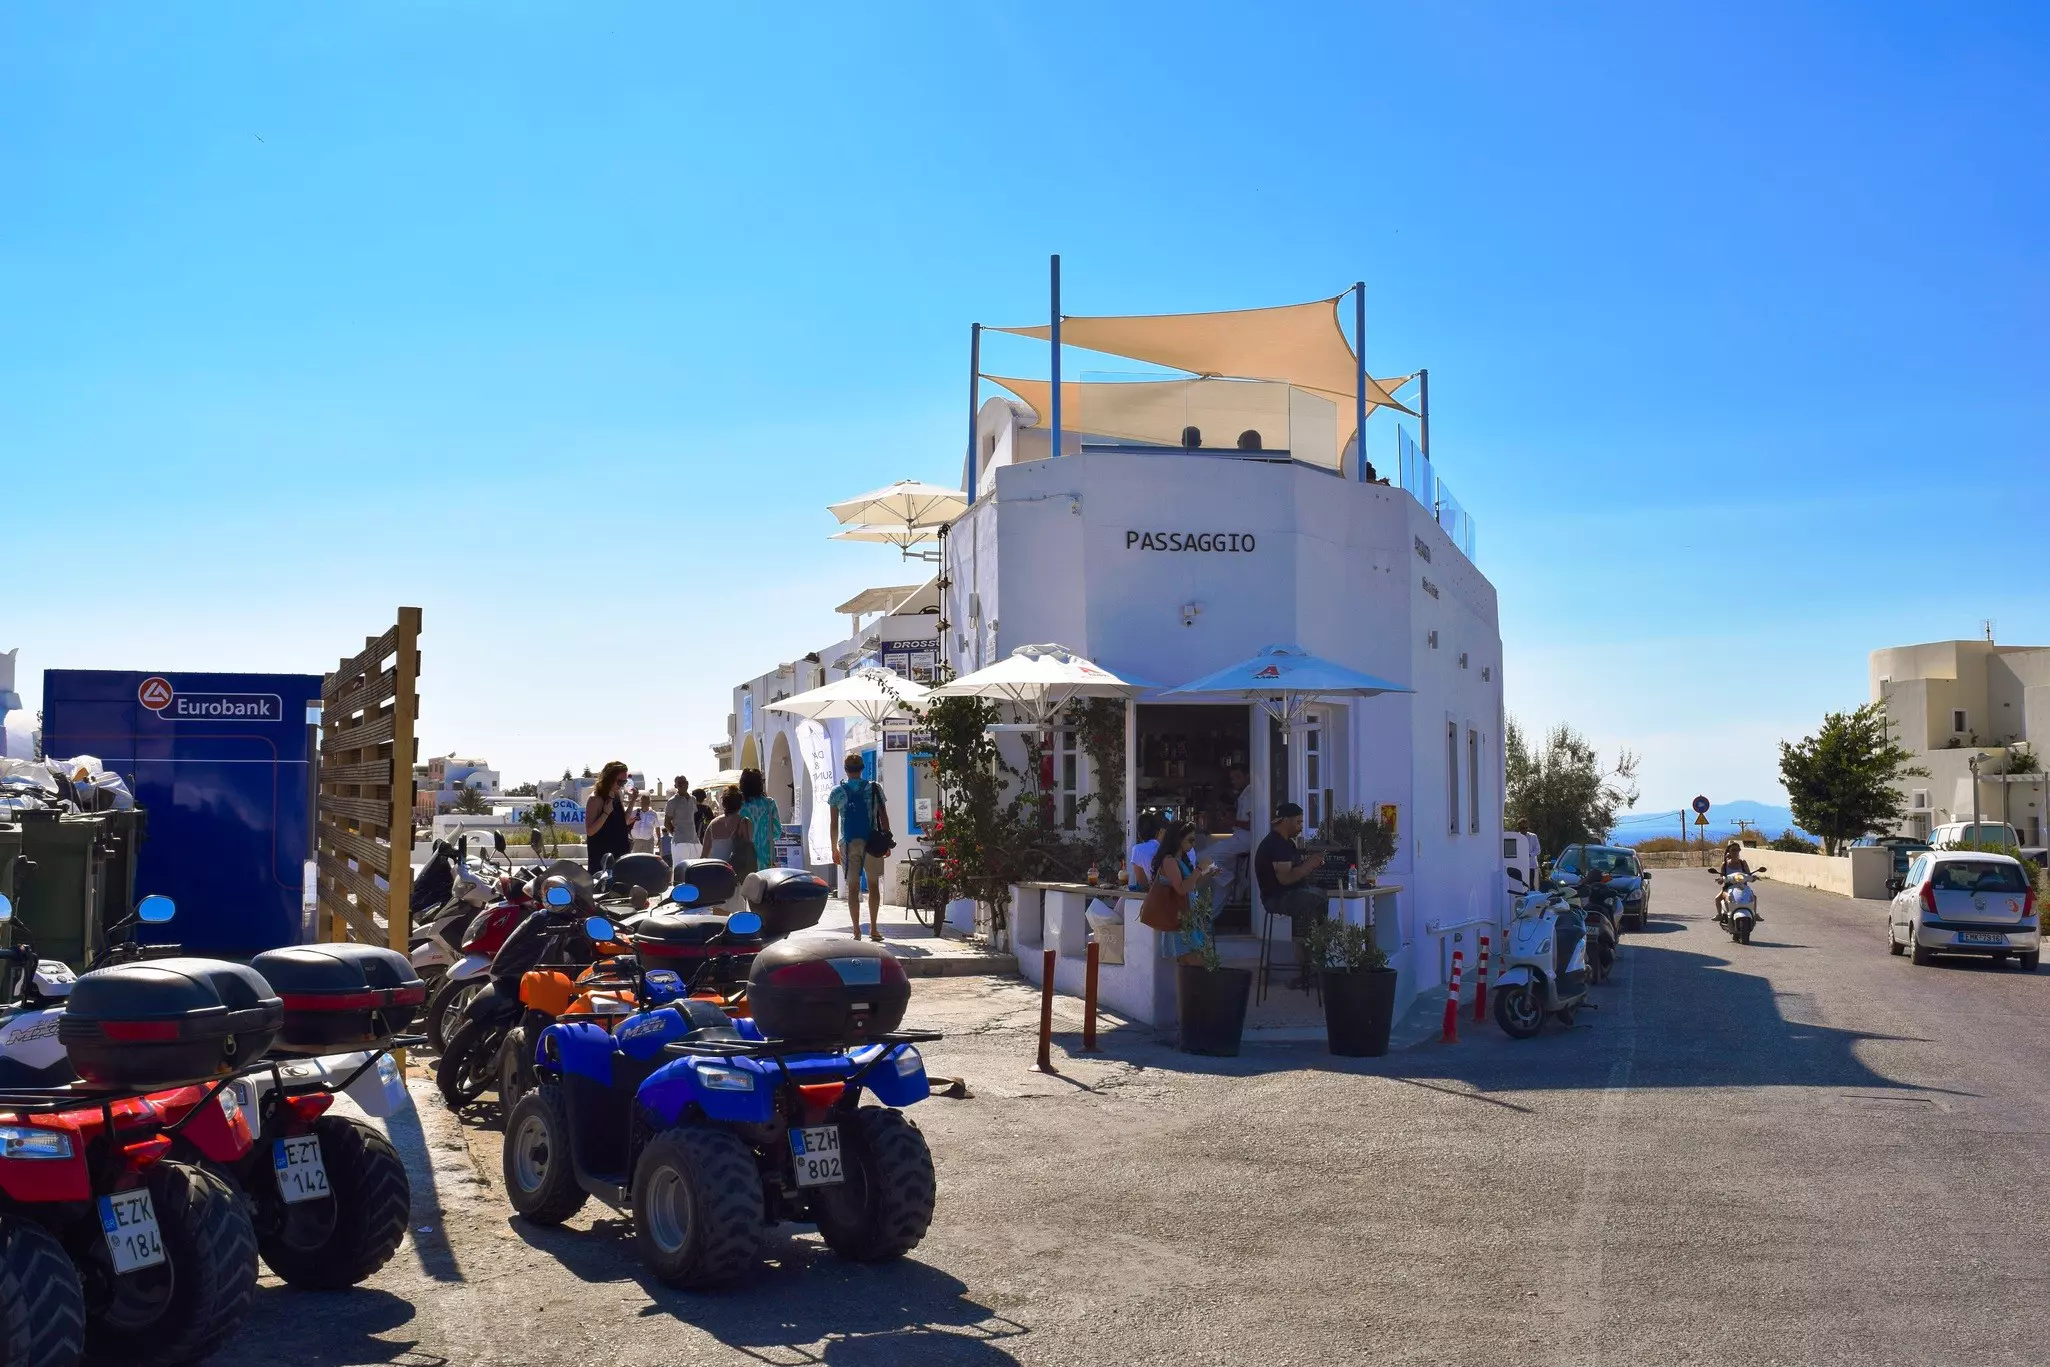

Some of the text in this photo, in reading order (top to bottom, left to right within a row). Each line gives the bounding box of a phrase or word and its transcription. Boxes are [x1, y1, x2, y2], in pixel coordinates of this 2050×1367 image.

[1126, 530, 1256, 553] PASSAGGIO
[177, 698, 271, 716] Eurobank
[553, 801, 577, 810] OCAL
[804, 1130, 838, 1152] EZH
[286, 1141, 318, 1165] EZT
[808, 1157, 841, 1179] 802
[293, 1169, 328, 1193] 142
[112, 1195, 153, 1227] EZK
[126, 1230, 161, 1260] 184
